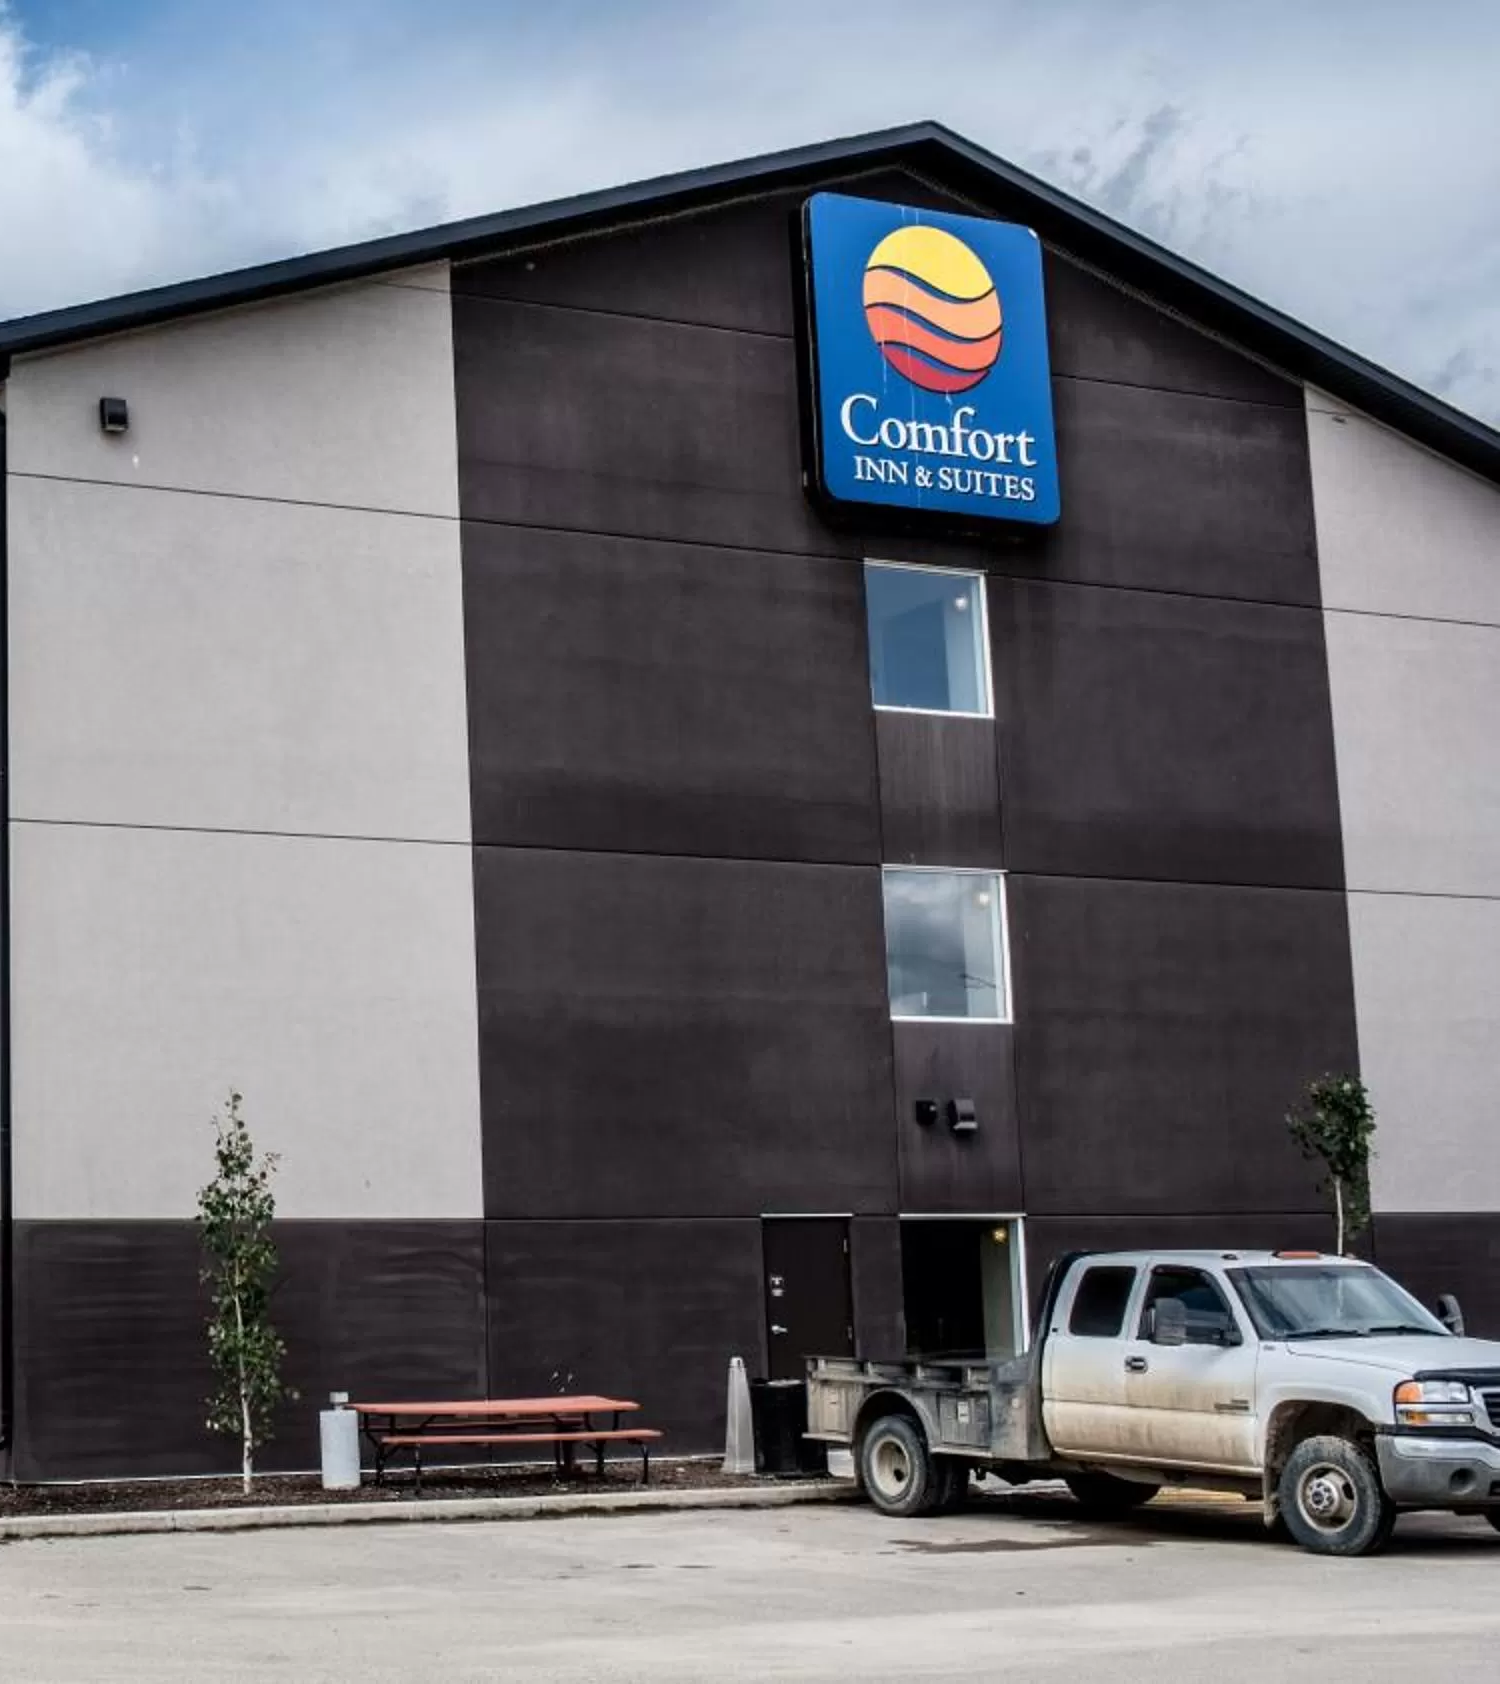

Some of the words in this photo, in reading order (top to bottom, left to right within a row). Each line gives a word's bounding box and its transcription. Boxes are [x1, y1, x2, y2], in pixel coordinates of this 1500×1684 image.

[840, 393, 1038, 467] Comfort
[854, 455, 908, 485] INN
[915, 465, 933, 489] &
[938, 467, 1036, 501] SUITES
